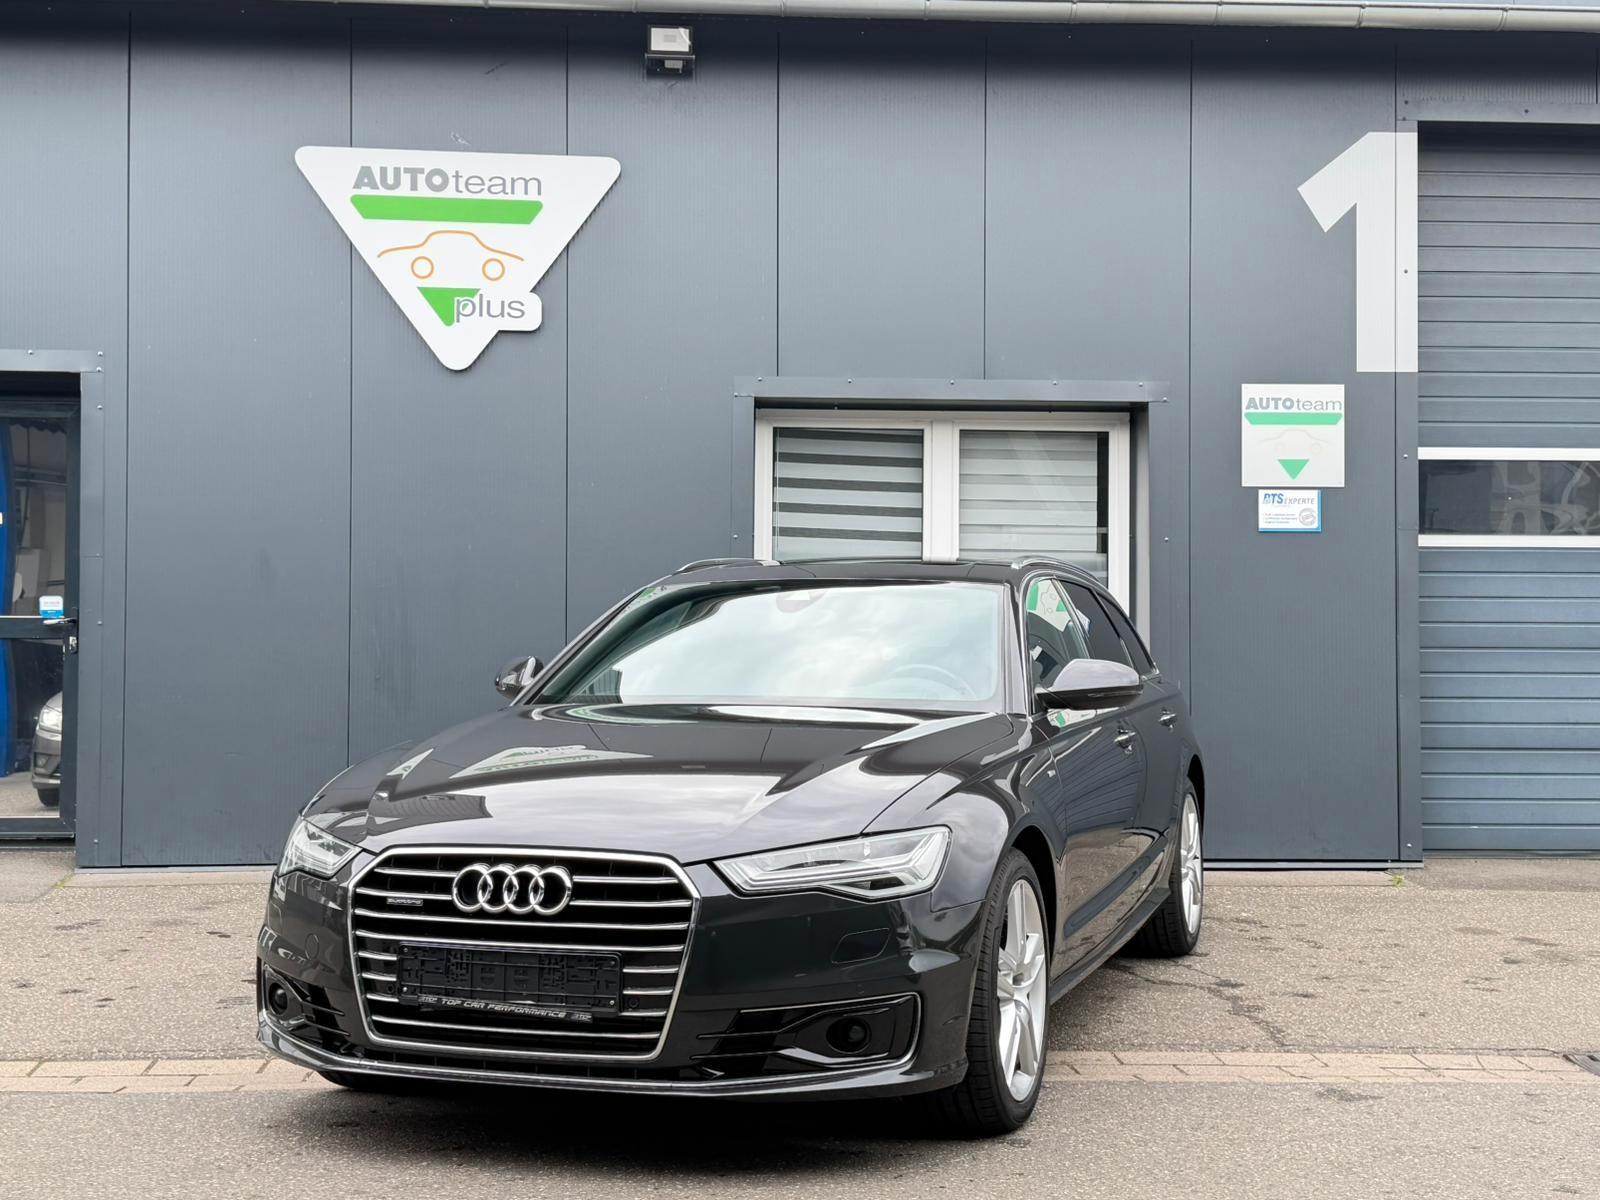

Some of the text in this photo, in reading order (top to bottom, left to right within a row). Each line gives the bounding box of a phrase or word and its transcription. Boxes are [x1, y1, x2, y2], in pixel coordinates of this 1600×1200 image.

[352, 165, 542, 197] AUTOteam
[1297, 131, 1418, 372] 1
[455, 293, 526, 323] plus
[1245, 397, 1343, 411] AUTOteam
[441, 998, 462, 1006] TOP
[463, 1000, 486, 1009] CAR
[487, 1003, 567, 1019] PERFORMANCE
